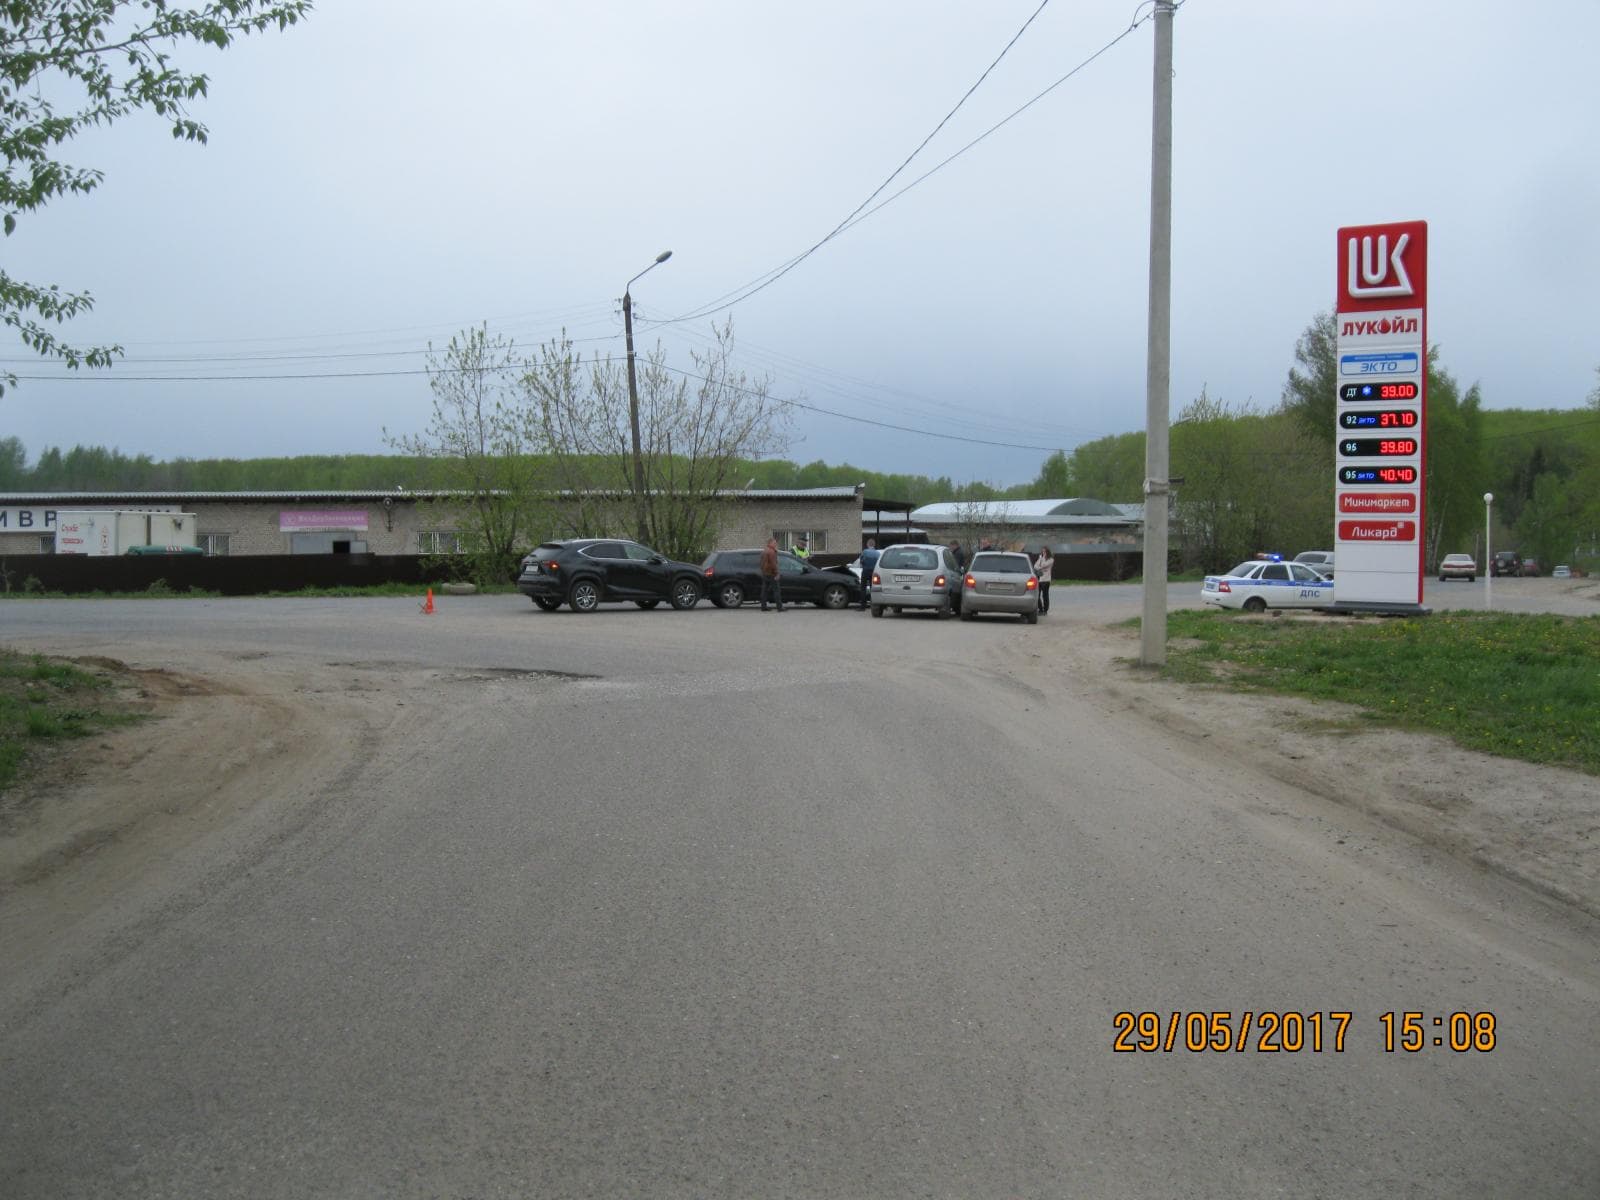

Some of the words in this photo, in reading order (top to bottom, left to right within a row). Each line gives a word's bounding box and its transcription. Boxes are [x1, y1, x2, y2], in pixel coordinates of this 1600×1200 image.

[1342, 316, 1418, 336] ЛУКОЙЛ
[1360, 361, 1398, 373] ЭКТО
[1346, 387, 1358, 398] ДТ
[1381, 385, 1414, 397] 39.00
[1346, 415, 1357, 424] 92
[1381, 413, 1413, 425] 37.10
[1380, 441, 1413, 453] 39.80
[1345, 470, 1356, 479] 95
[1380, 469, 1412, 481] 40.40
[1344, 497, 1410, 509] Минимаркет
[1351, 526, 1398, 539] Ликард
[1300, 590, 1320, 599] ДПС
